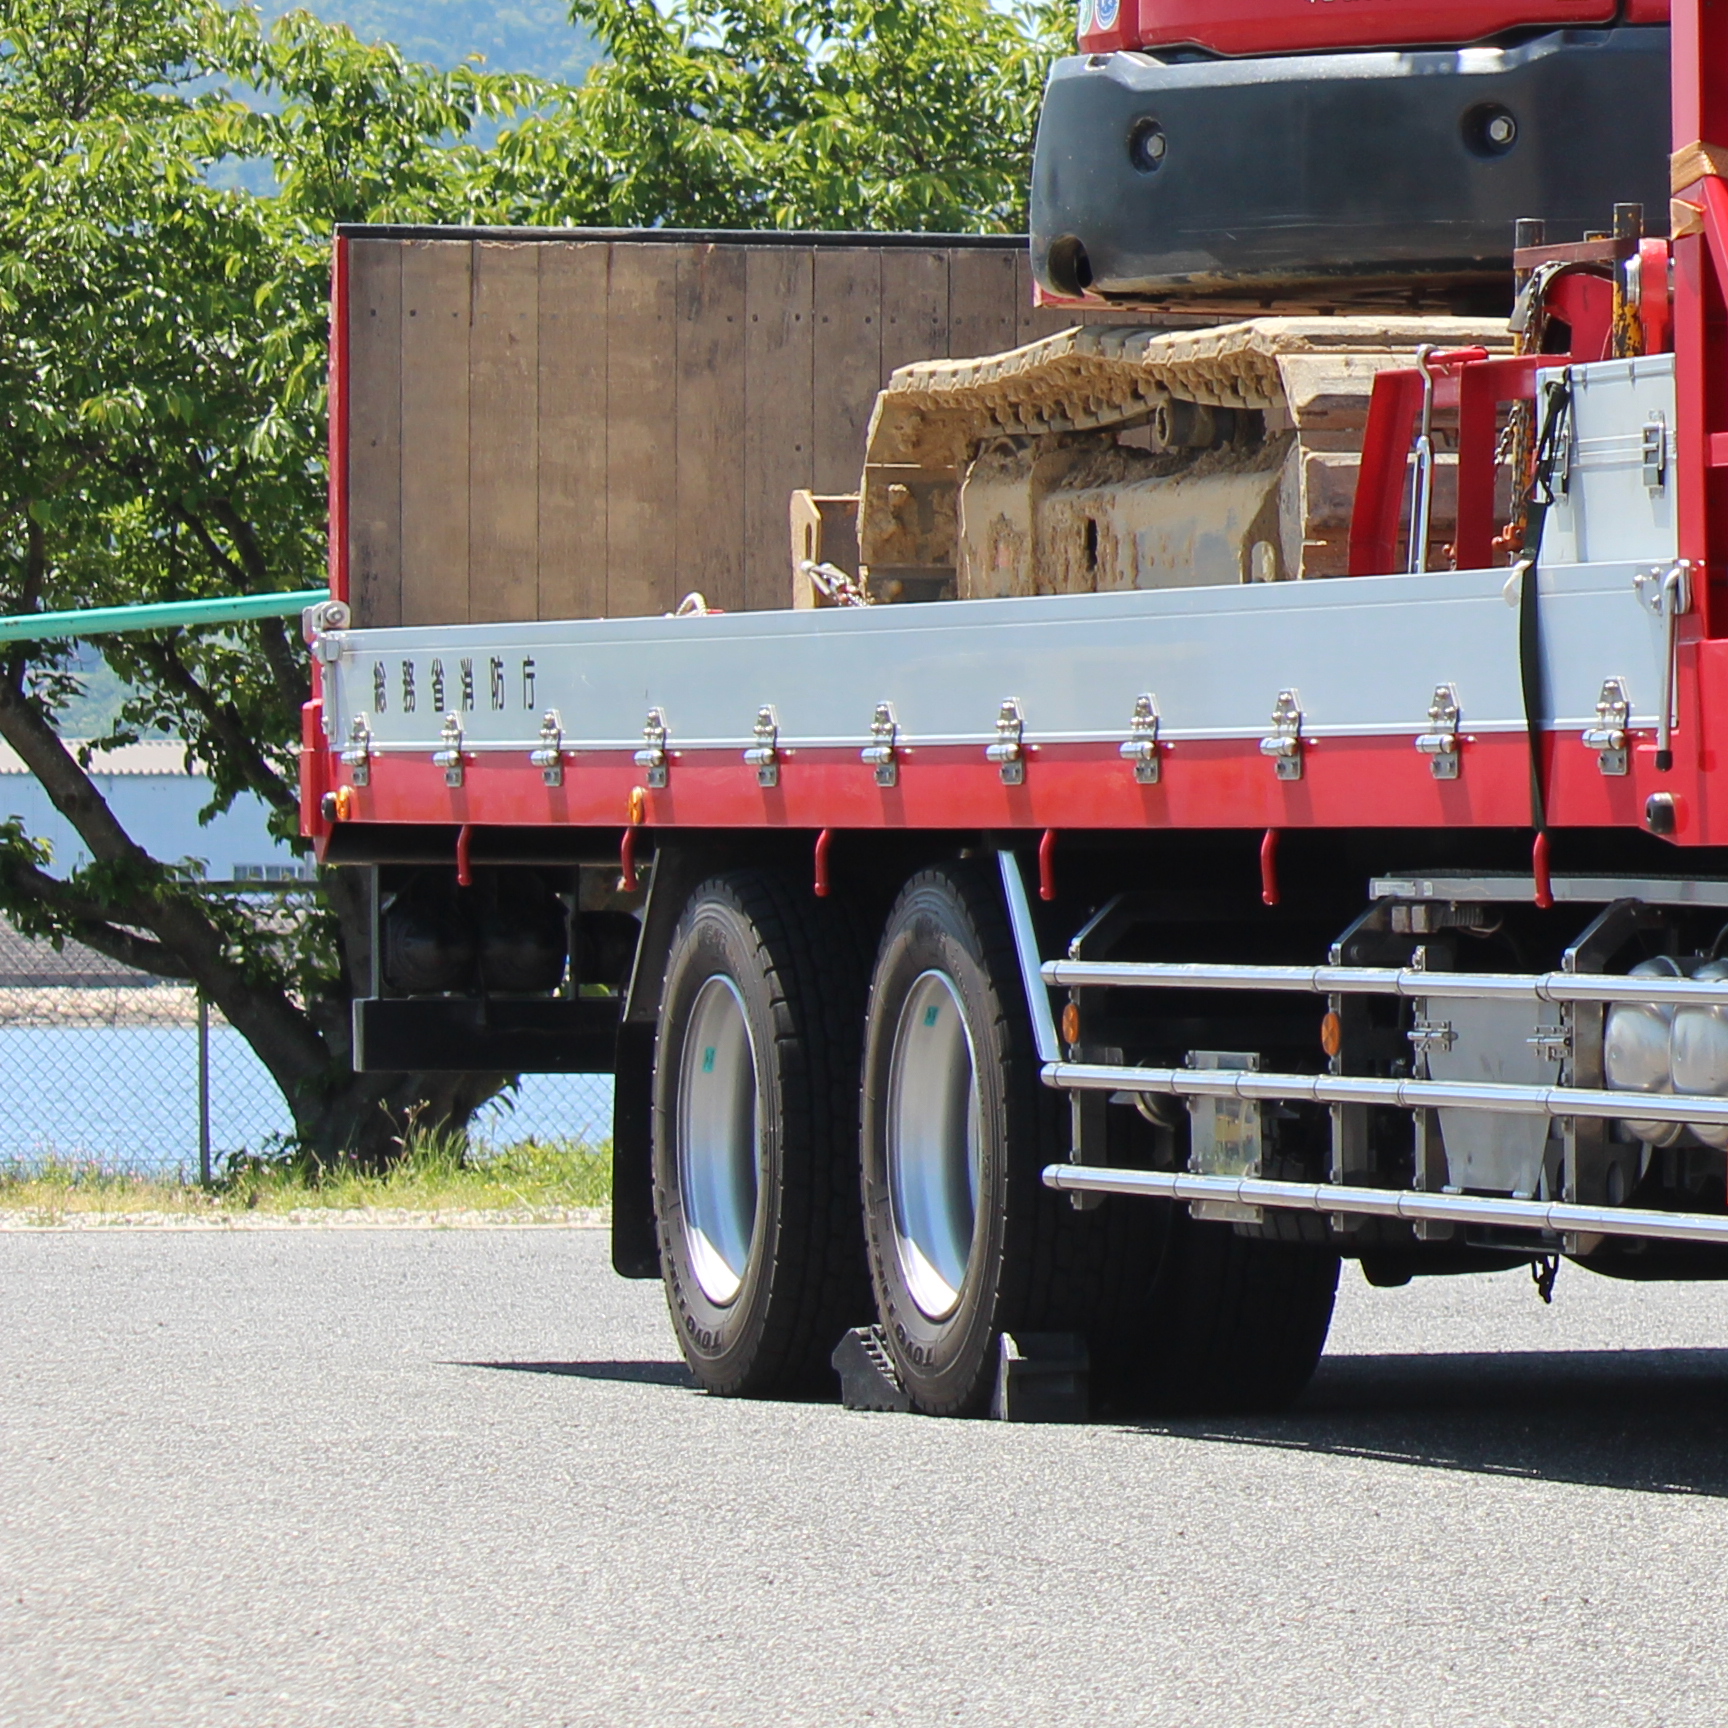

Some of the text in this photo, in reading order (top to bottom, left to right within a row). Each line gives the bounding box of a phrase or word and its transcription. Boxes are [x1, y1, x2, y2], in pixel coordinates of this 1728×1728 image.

[373, 654, 536, 715] 総務省消防庁
